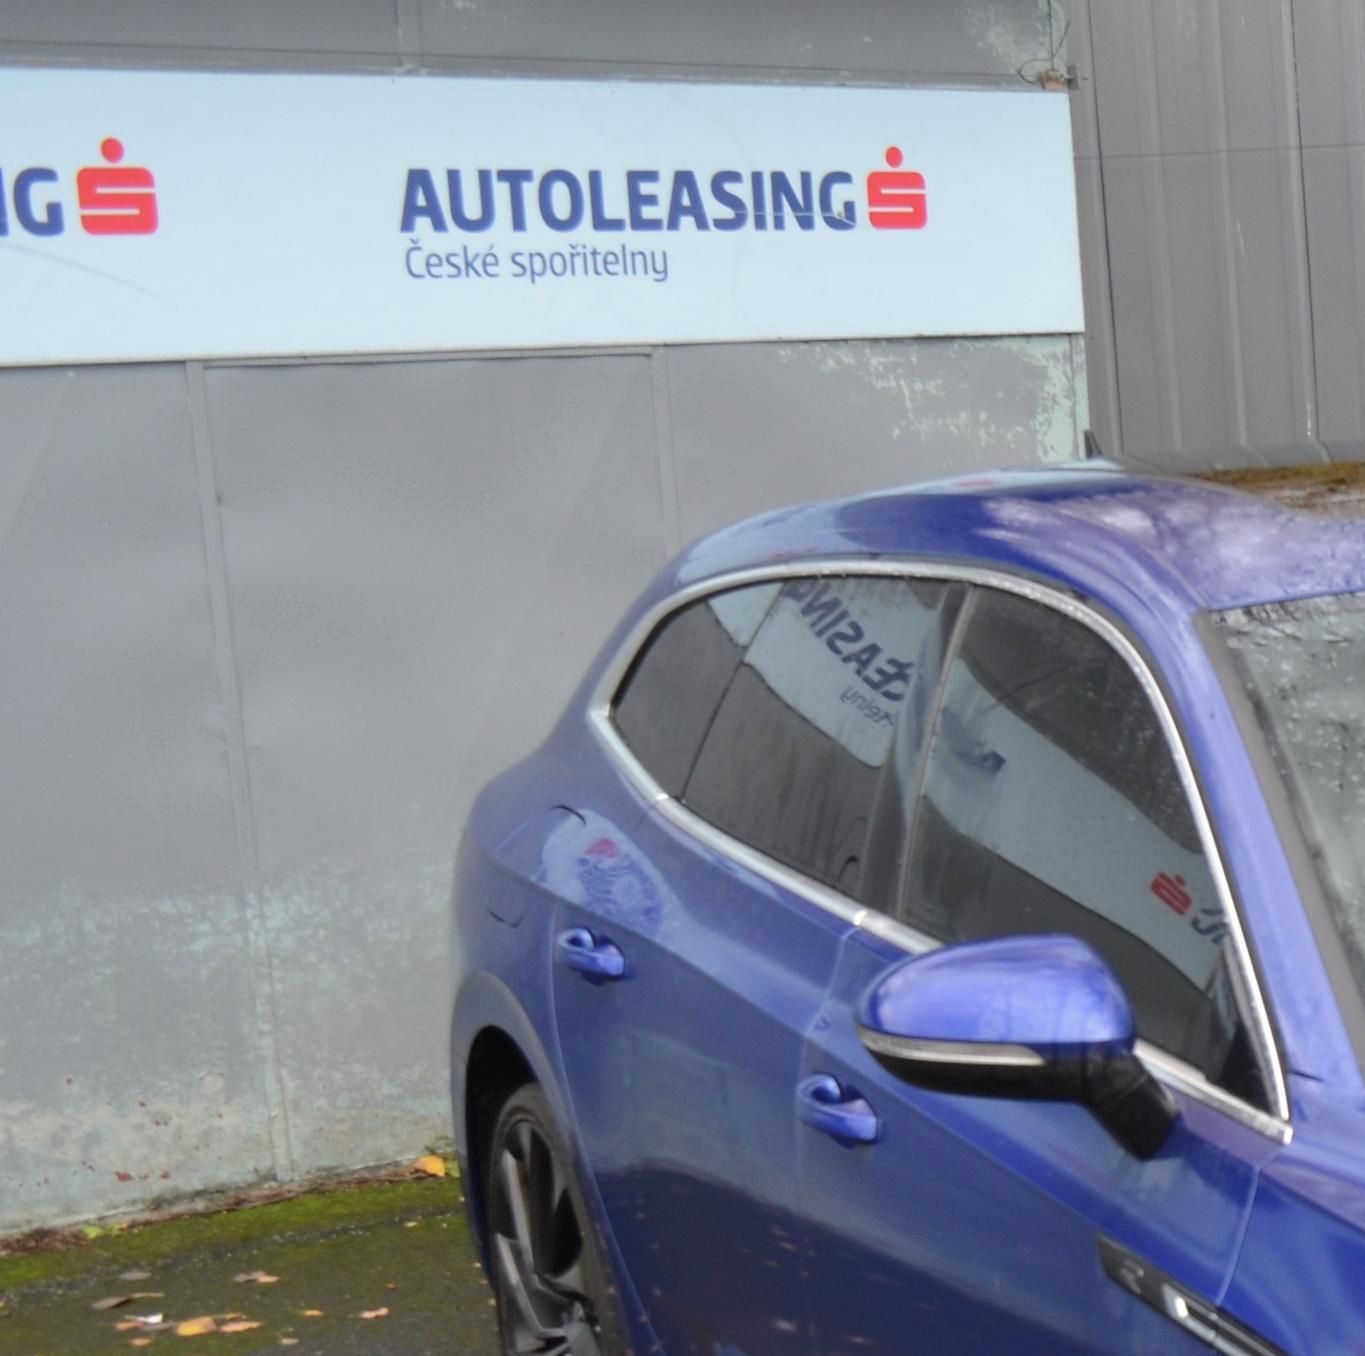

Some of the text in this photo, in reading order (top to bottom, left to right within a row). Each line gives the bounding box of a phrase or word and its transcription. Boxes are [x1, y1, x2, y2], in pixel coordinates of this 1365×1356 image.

[0, 168, 64, 236] G
[401, 169, 856, 232] AUTOLEASING
[405, 238, 669, 285] České spořitelny
